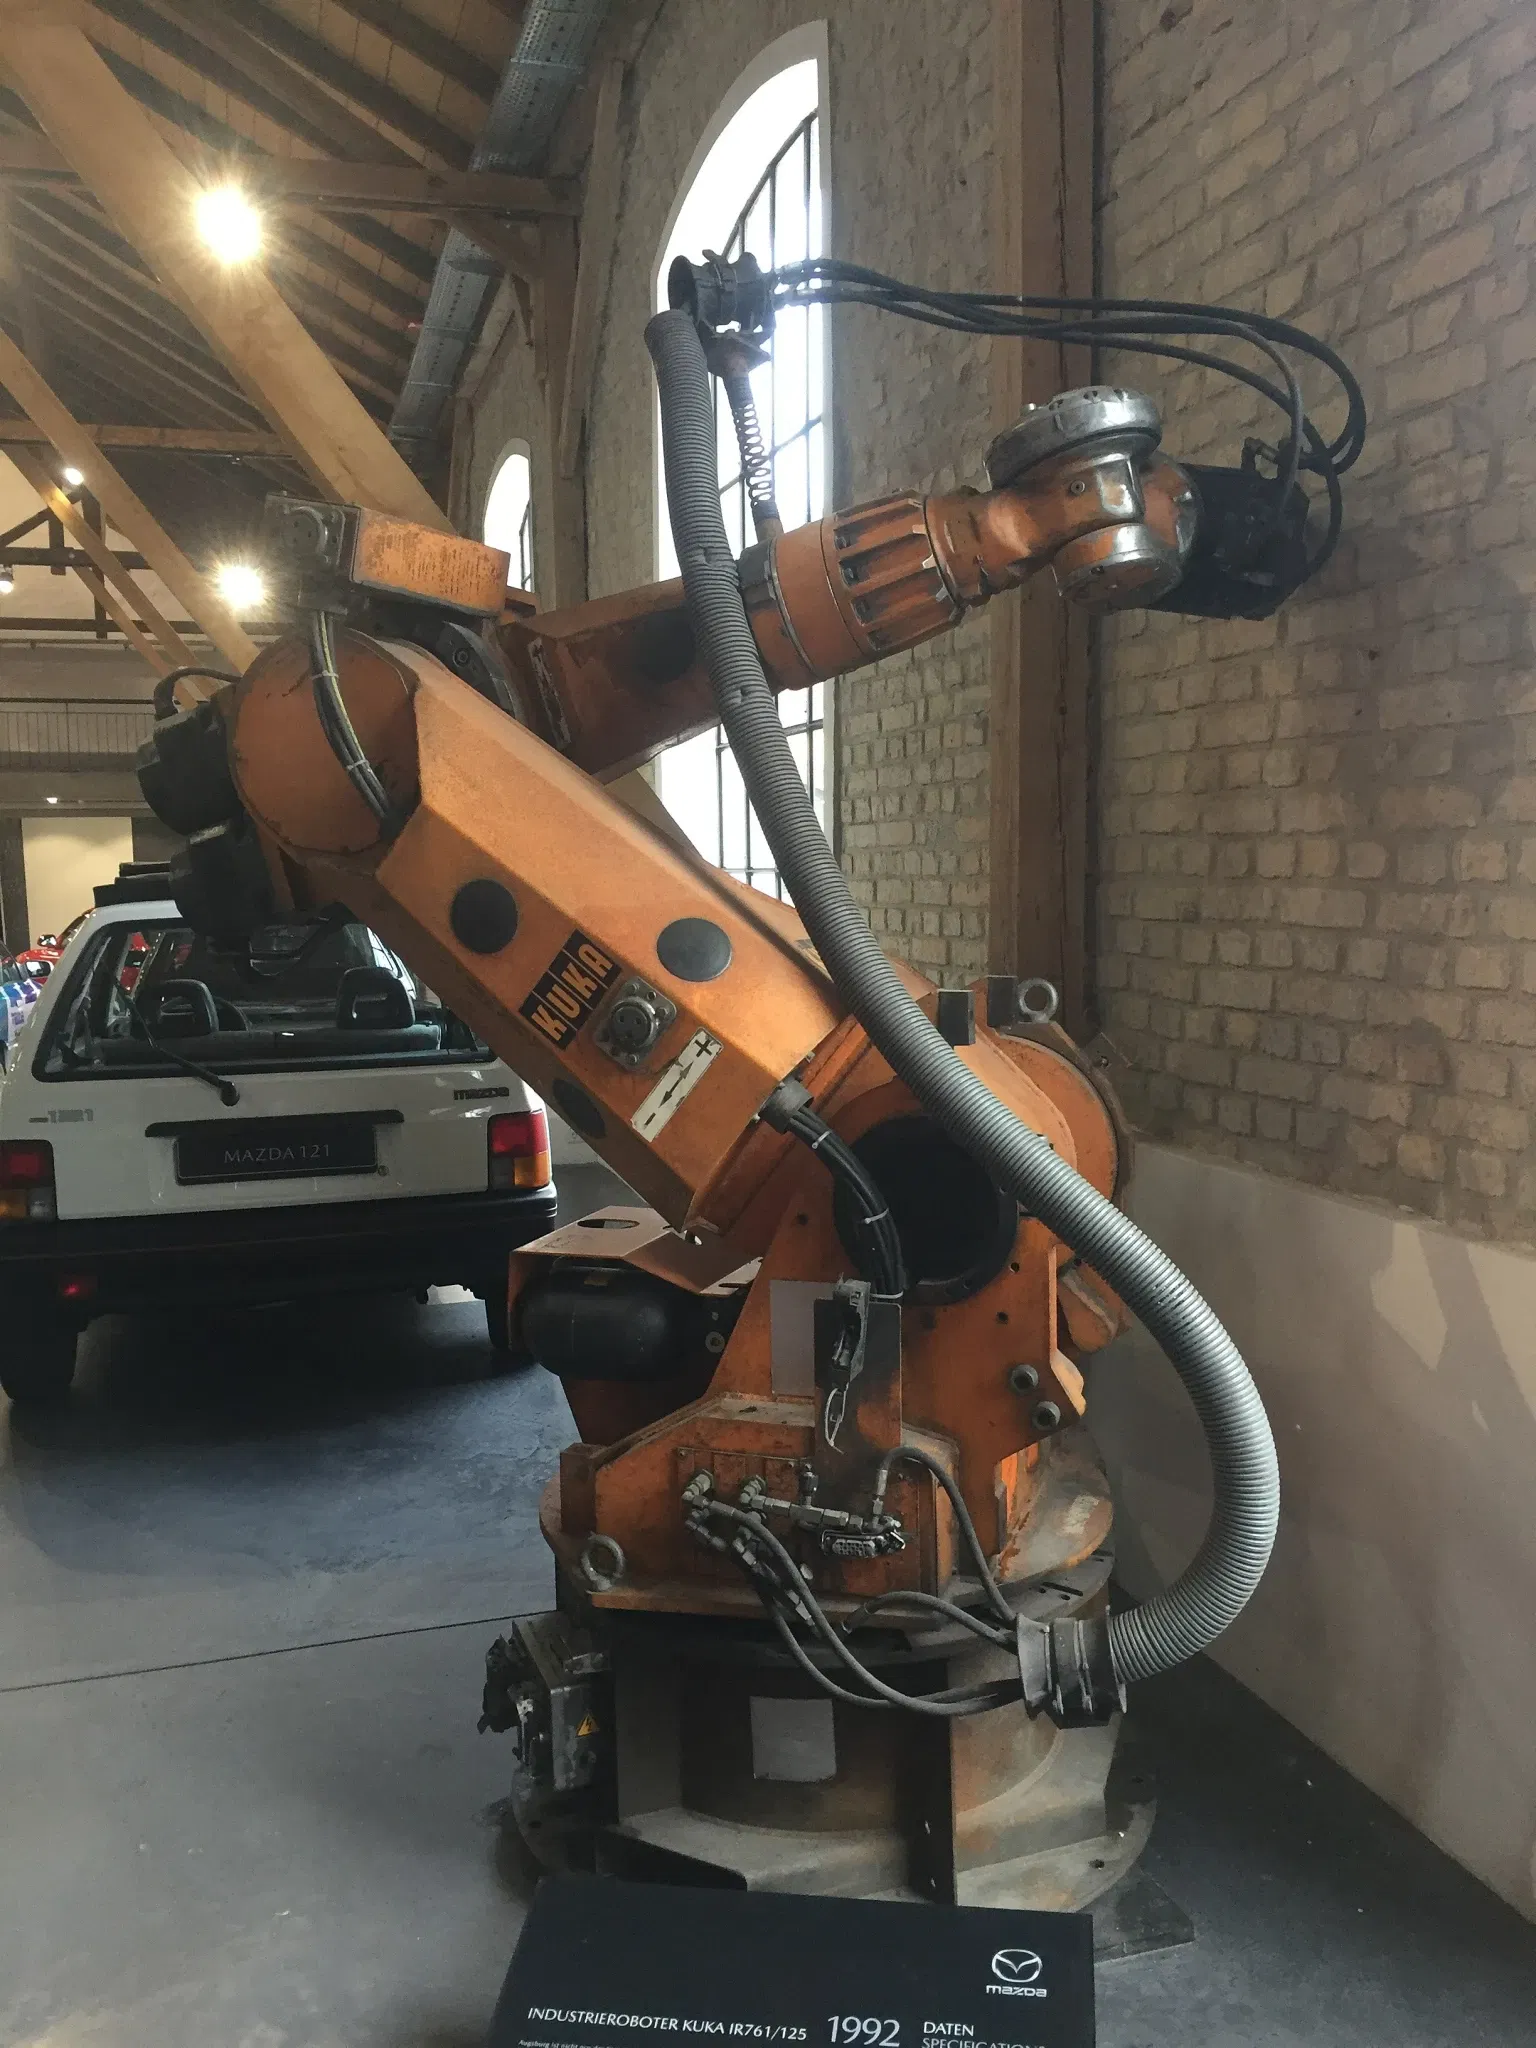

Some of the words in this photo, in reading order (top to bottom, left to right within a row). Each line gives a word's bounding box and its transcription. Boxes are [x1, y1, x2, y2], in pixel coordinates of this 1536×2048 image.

[531, 943, 614, 1041] KUKA
[224, 1146, 295, 1163] MAZDA
[300, 1144, 329, 1158] 121
[527, 2007, 678, 2031] INDUSTRIEROBOTER
[682, 2019, 725, 2035] KUKA
[729, 2022, 807, 2041] IR761/125
[827, 2015, 900, 2048] 1992
[923, 2021, 974, 2037] DATEN
